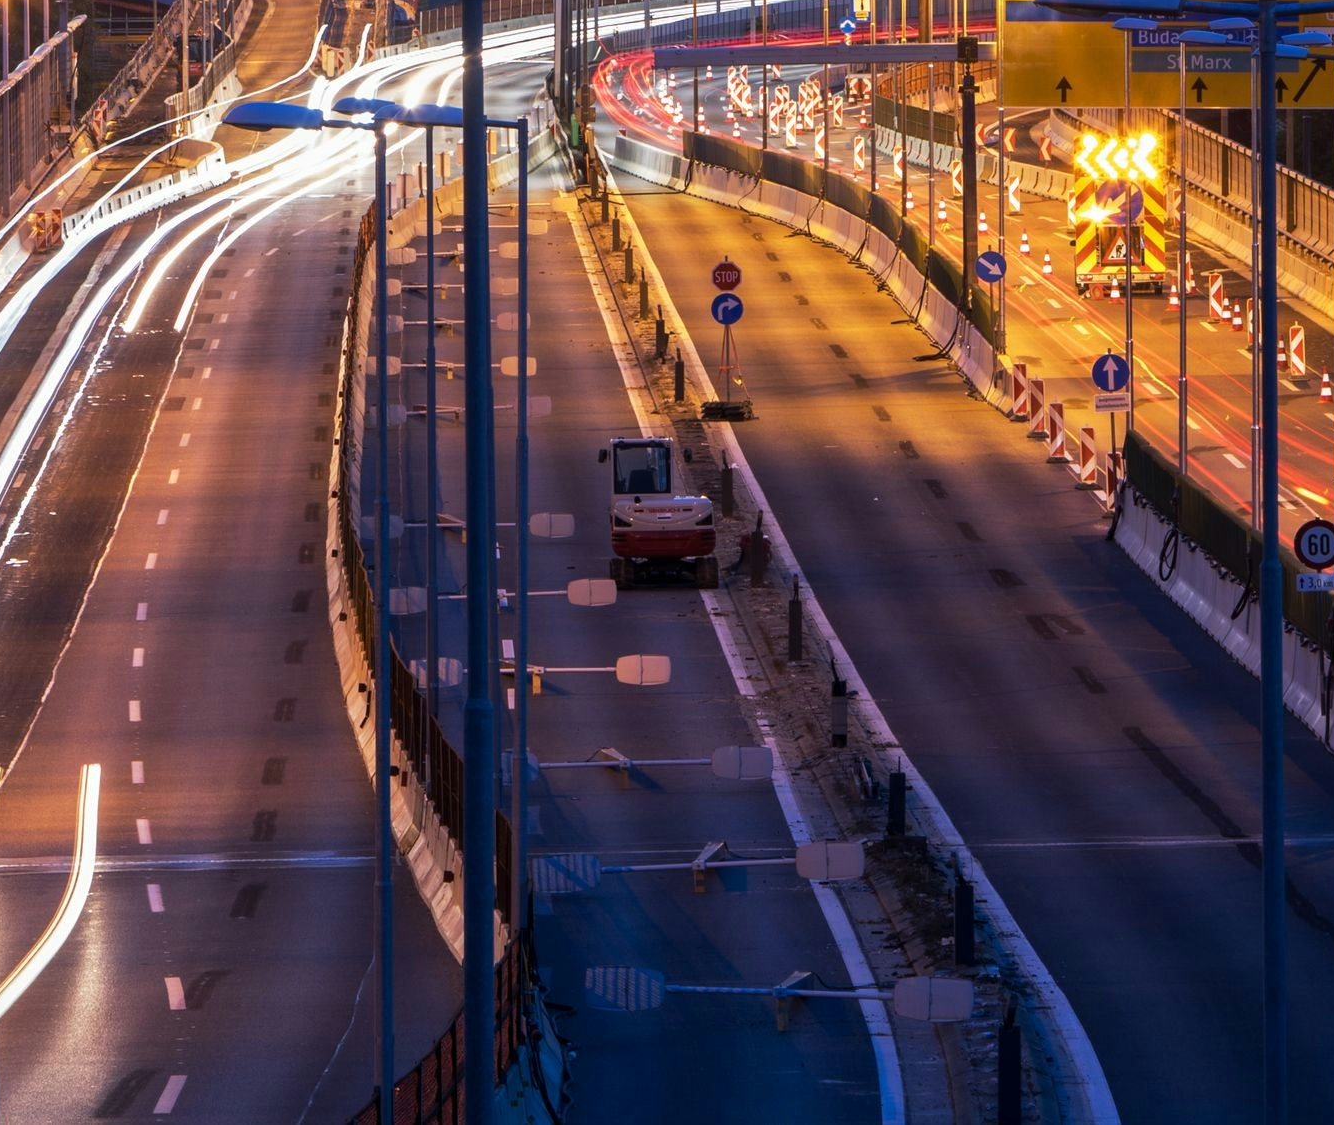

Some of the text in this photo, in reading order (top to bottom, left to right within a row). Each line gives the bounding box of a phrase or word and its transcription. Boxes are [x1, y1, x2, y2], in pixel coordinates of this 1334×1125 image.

[1191, 54, 1232, 69] Marx
[715, 271, 739, 283] STOP
[1308, 533, 1330, 556] 60
[1308, 577, 1334, 589] 3,0 km
